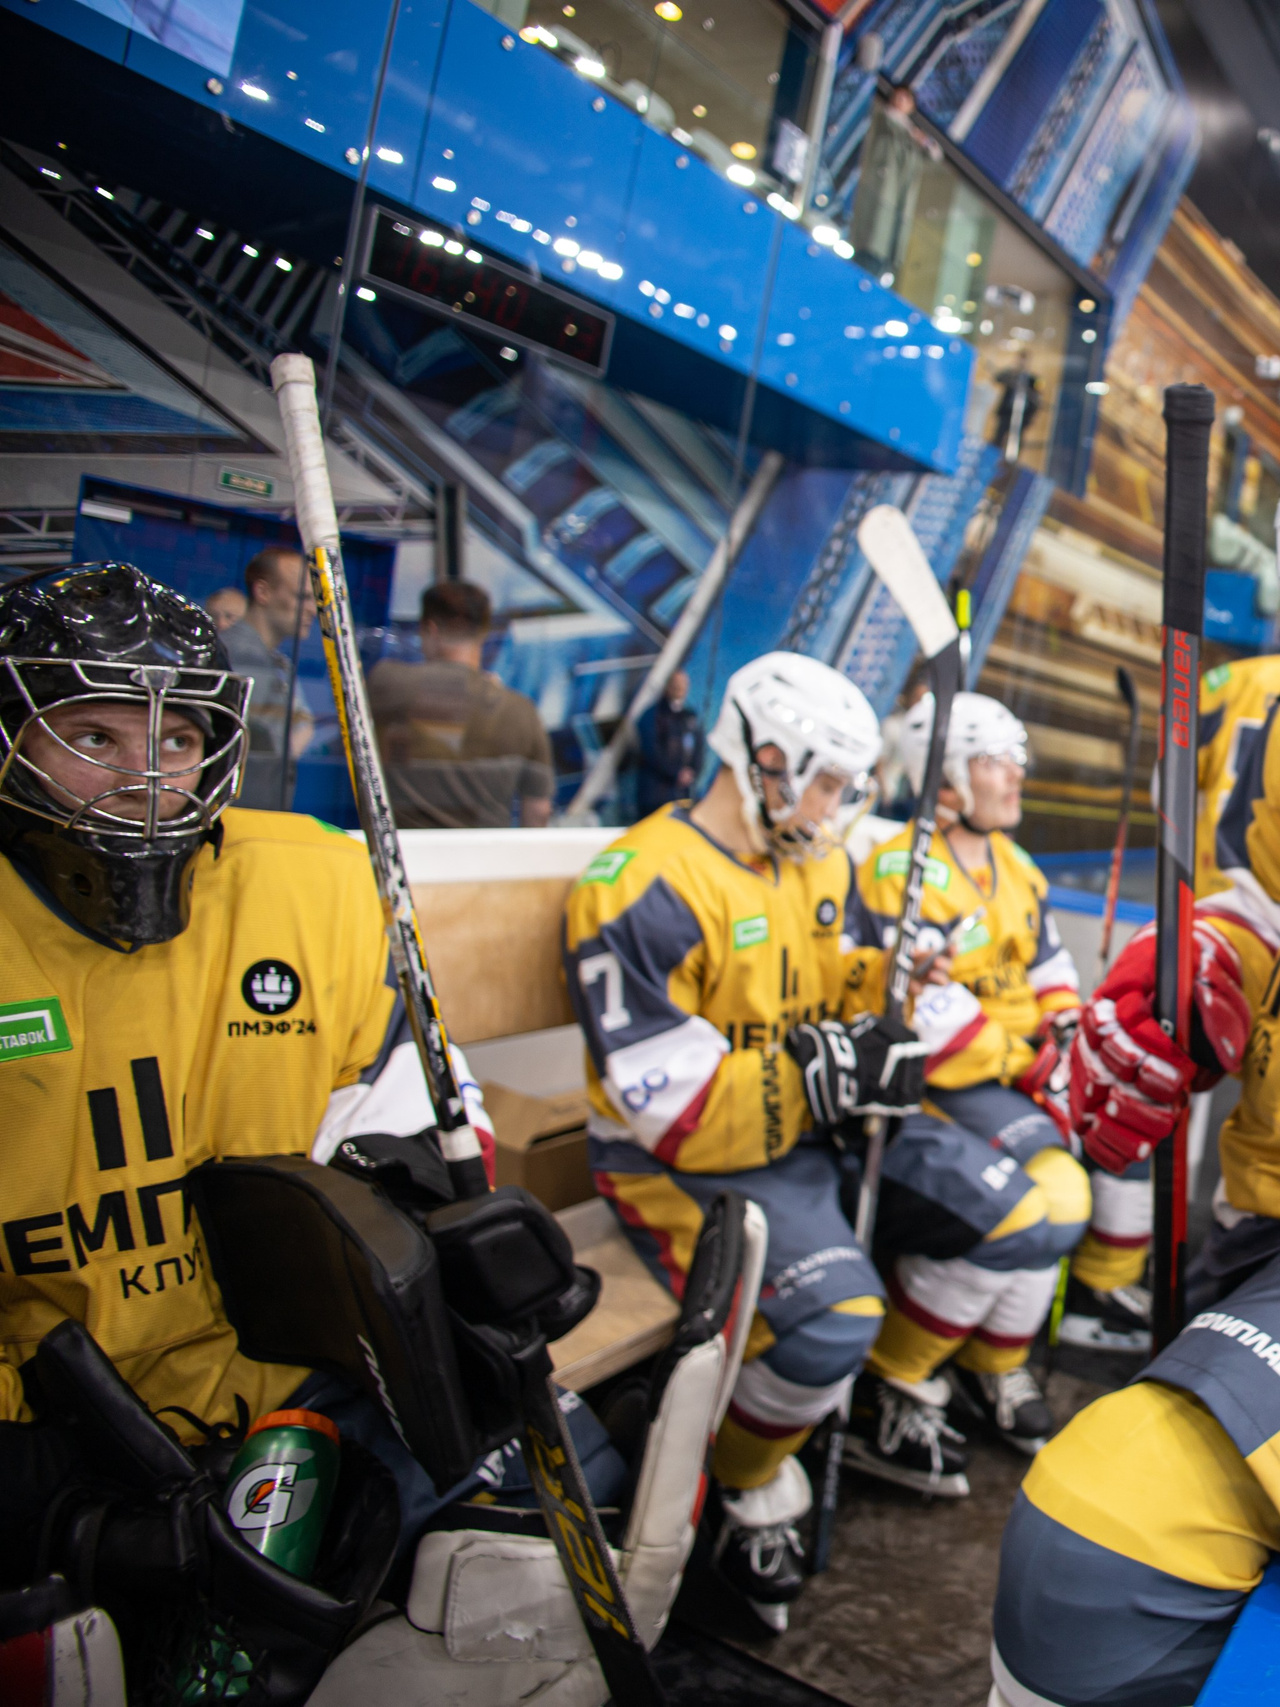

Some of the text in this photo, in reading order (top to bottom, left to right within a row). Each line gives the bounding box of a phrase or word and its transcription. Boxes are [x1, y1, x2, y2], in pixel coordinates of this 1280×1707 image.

[579, 952, 632, 1033] 7
[0, 1177, 193, 1277] ЕМП
[228, 1462, 300, 1531] G
